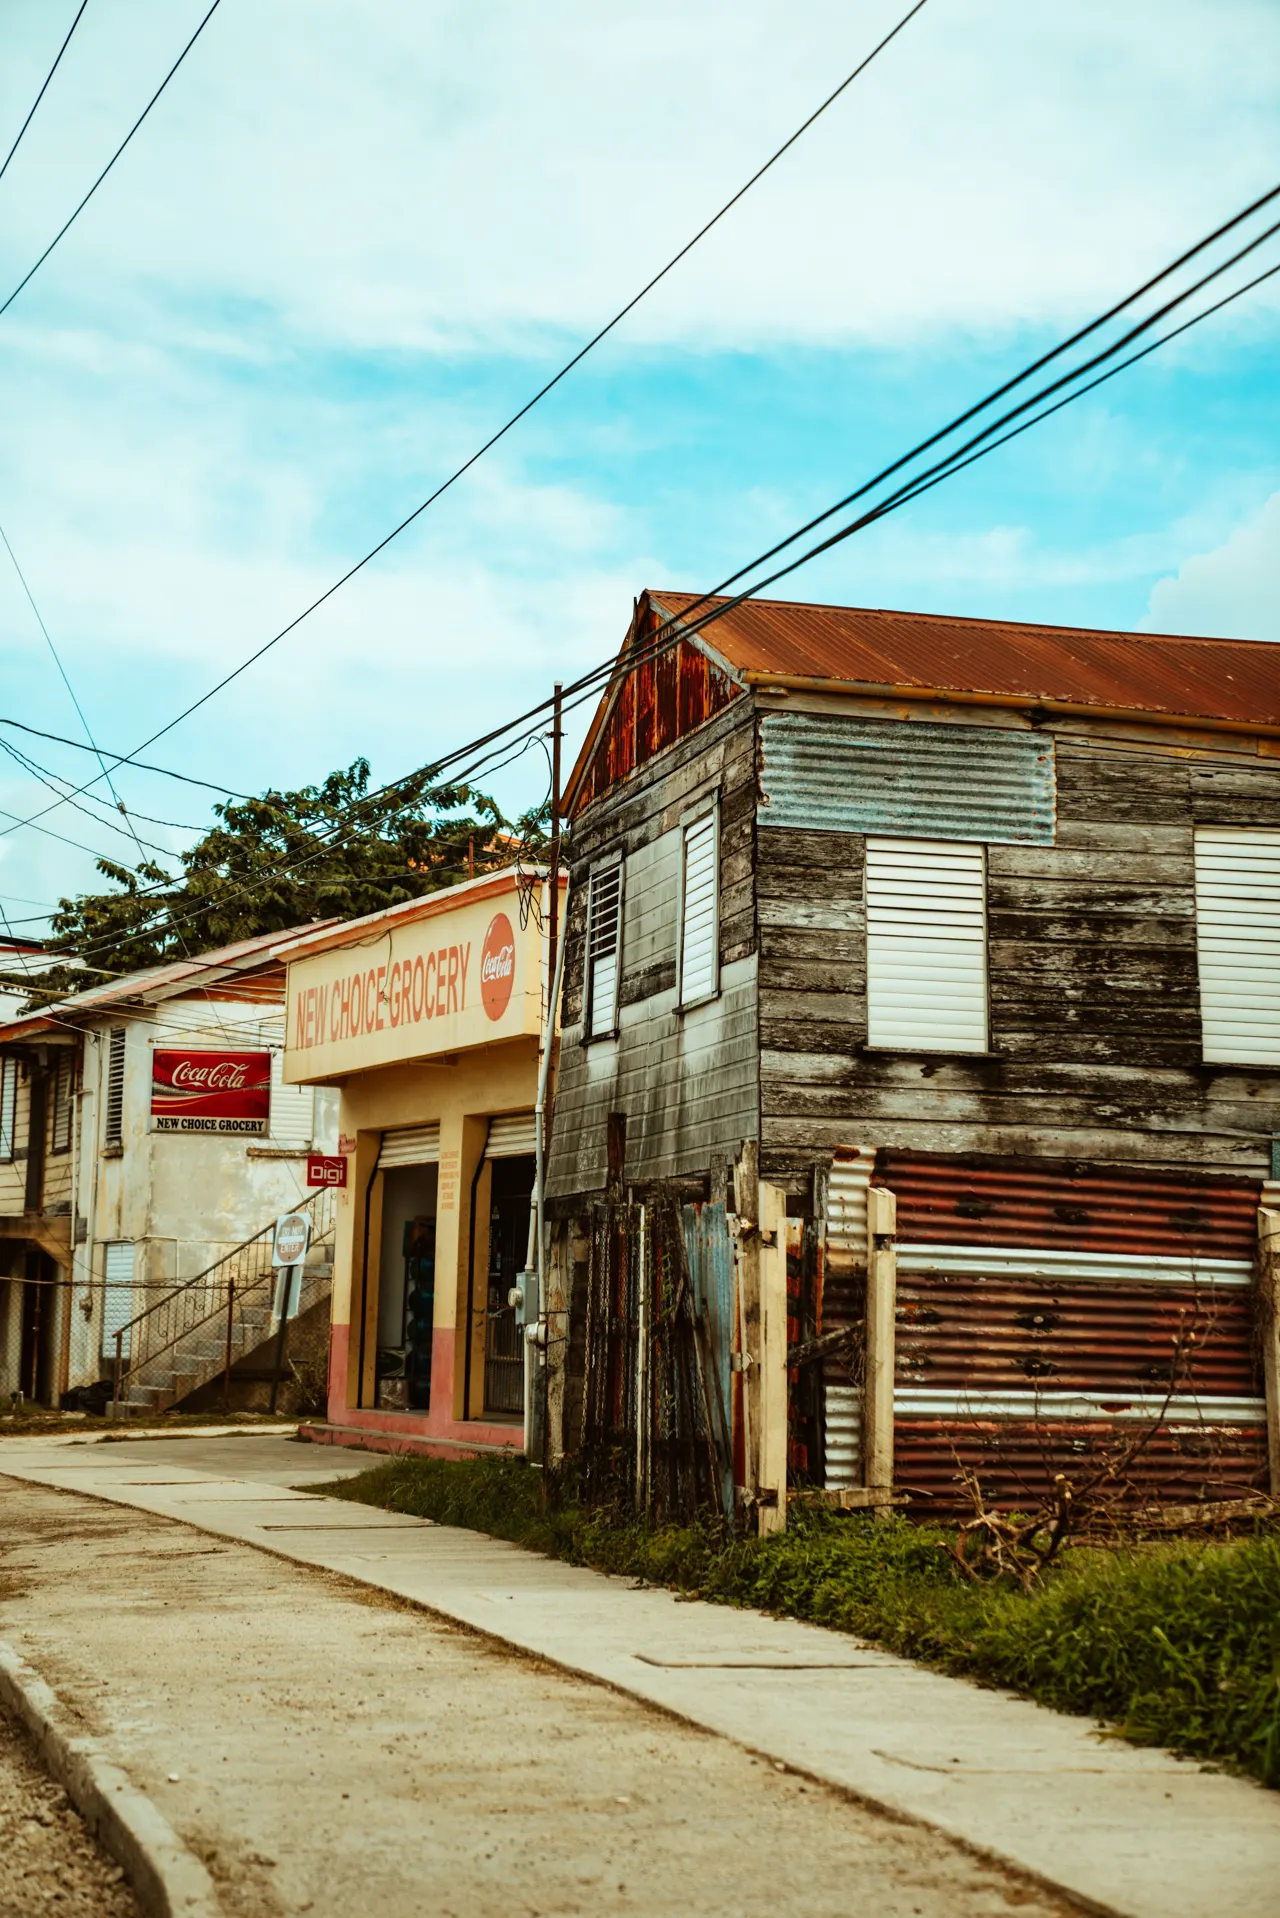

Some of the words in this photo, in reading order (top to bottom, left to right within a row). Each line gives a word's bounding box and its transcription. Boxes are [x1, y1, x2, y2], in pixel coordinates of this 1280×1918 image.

[295, 983, 329, 1051] NEW
[330, 965, 387, 1043] CHOICE
[388, 941, 472, 1029] GROCERY
[171, 1060, 251, 1089] Coca-Cola
[156, 1117, 180, 1129] NEW
[181, 1118, 217, 1131] CHOICE
[219, 1119, 265, 1132] GROCERY
[292, 1225, 304, 1236] NOT
[280, 1243, 300, 1254] ENTER
